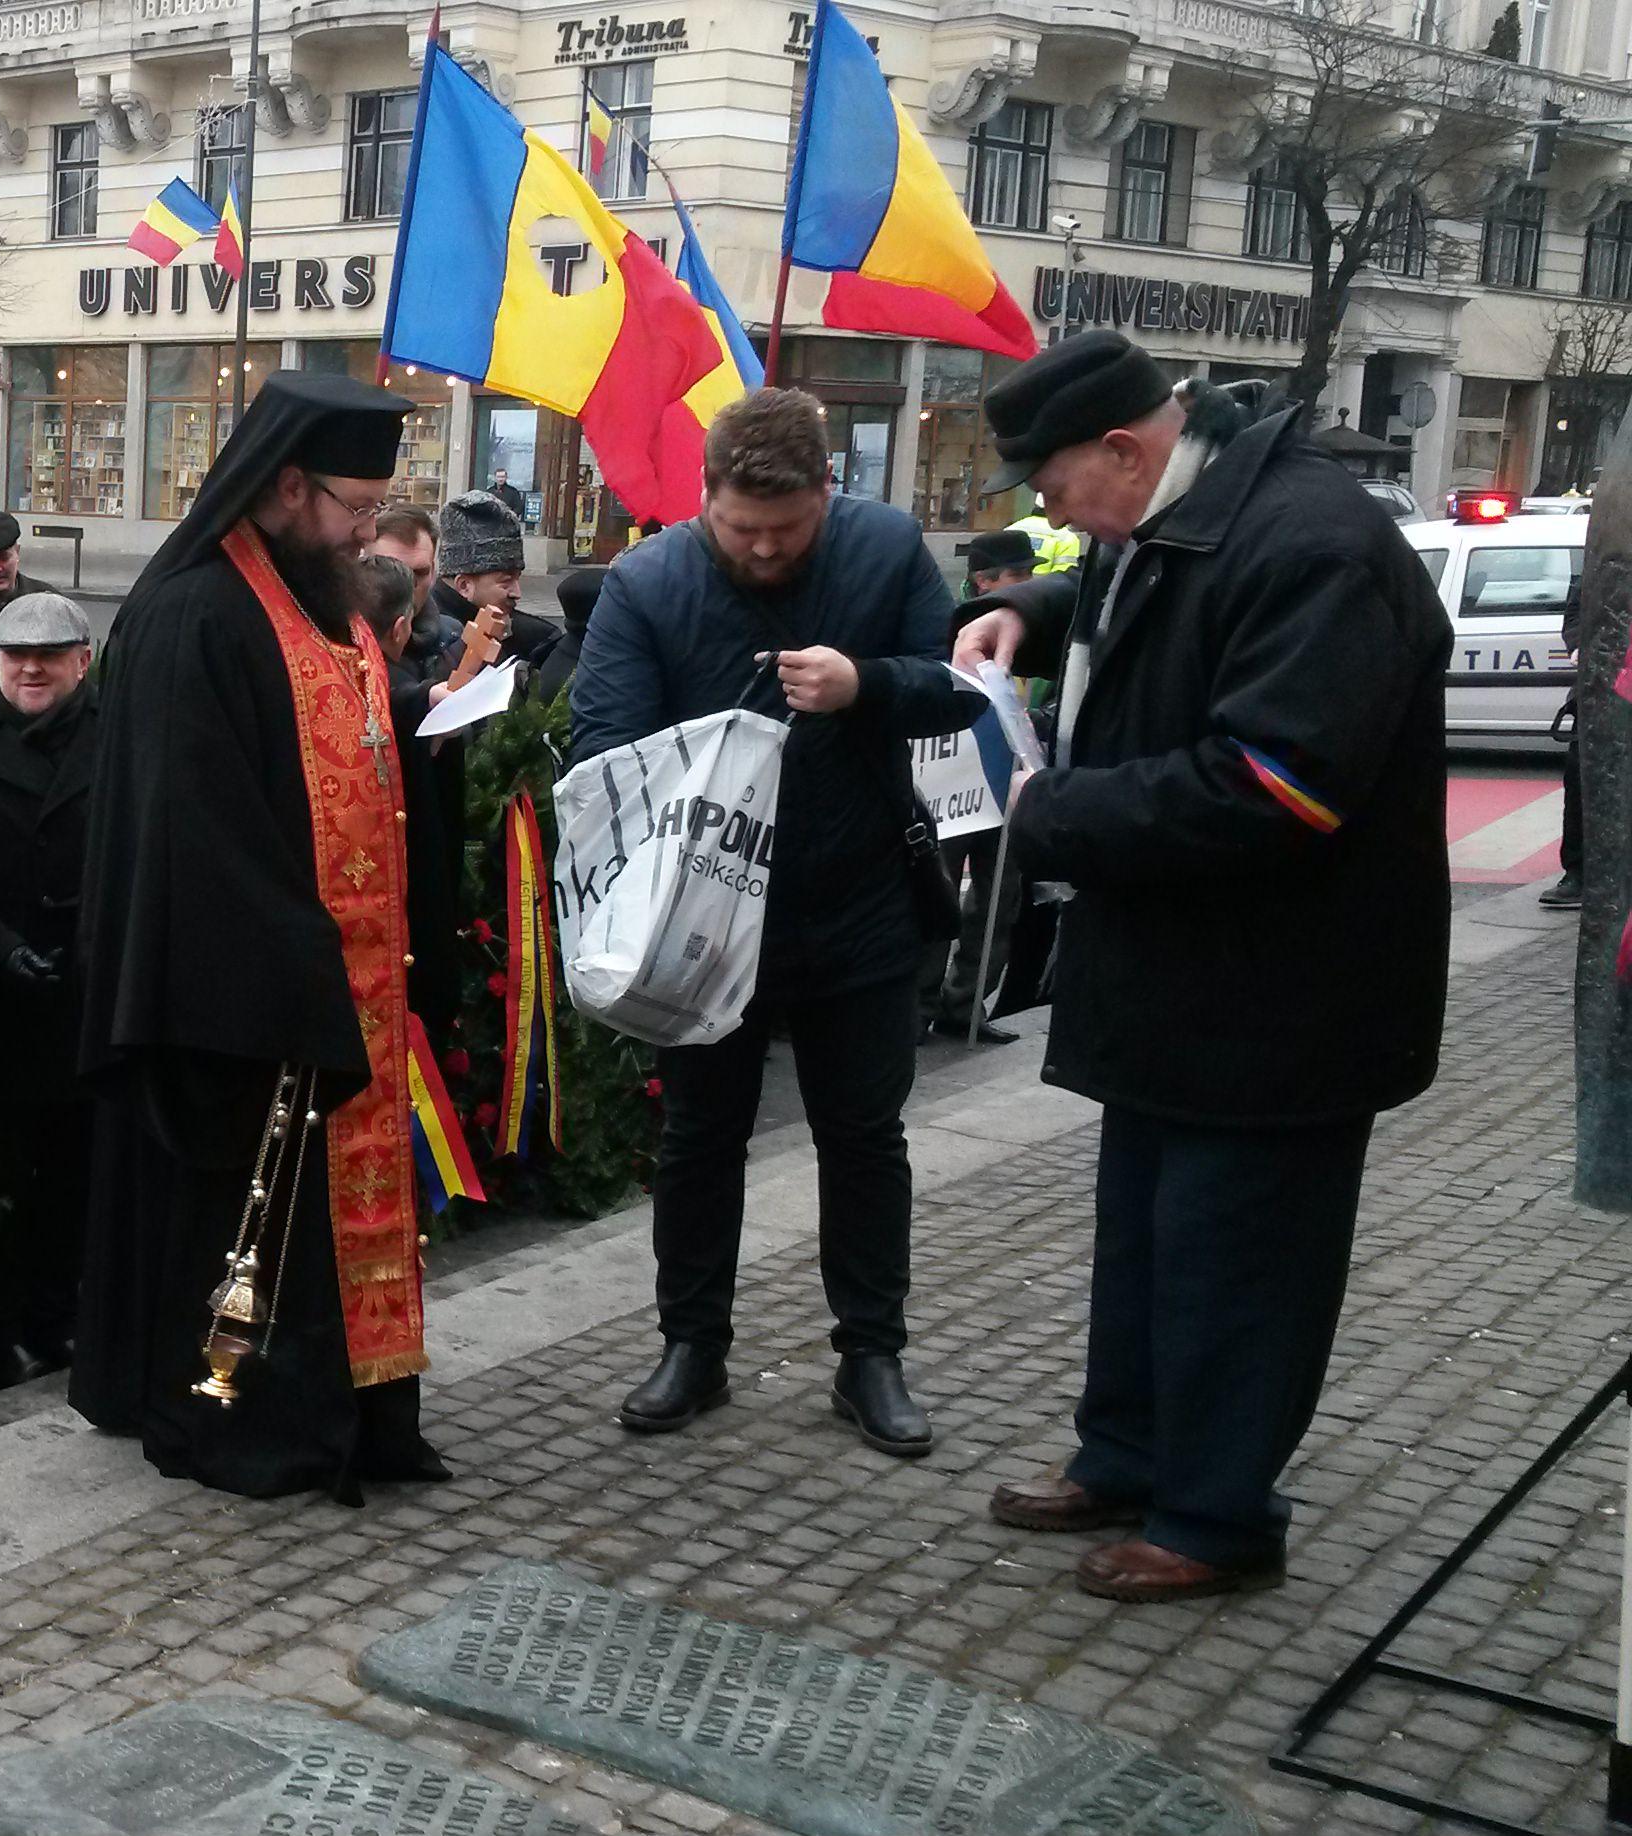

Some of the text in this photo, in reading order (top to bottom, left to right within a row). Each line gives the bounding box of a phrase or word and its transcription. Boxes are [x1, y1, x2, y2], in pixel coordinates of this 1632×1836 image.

[557, 15, 687, 51] Tribuna
[948, 787, 984, 820] CLUJ
[281, 1744, 335, 1800] IOAN
[323, 1751, 374, 1806] IOAN
